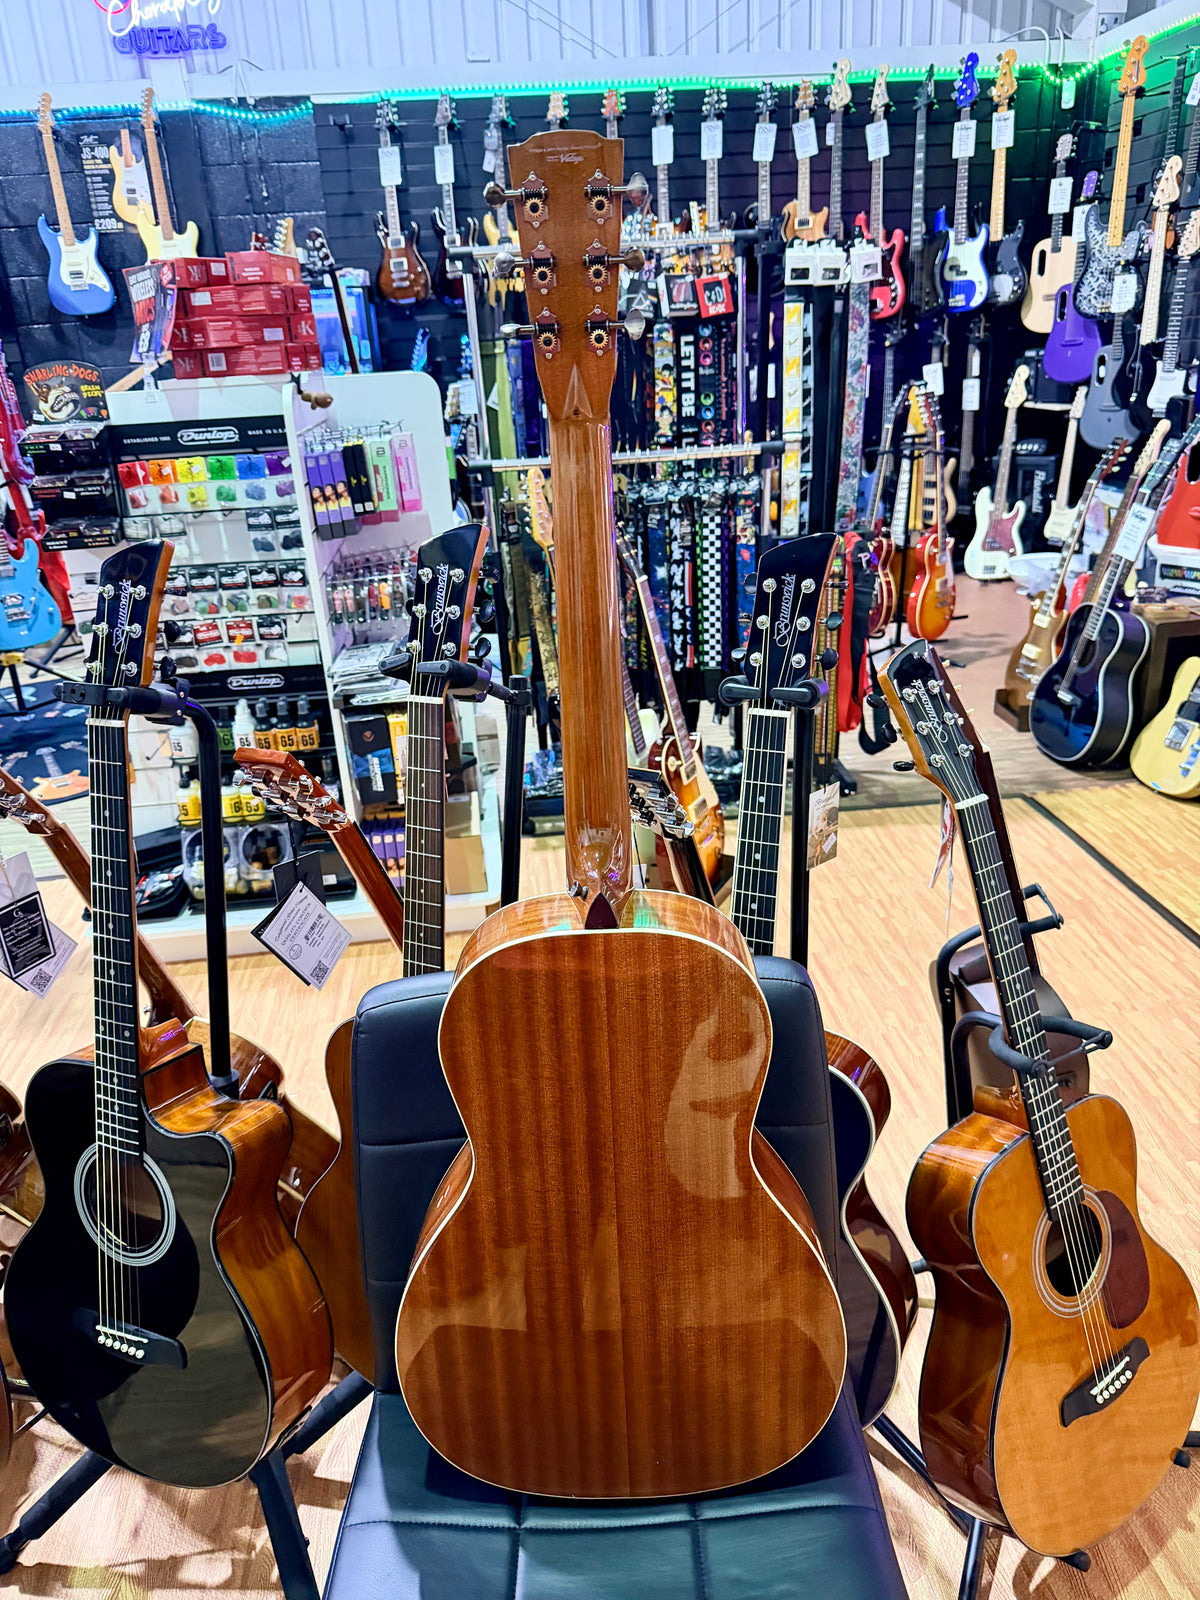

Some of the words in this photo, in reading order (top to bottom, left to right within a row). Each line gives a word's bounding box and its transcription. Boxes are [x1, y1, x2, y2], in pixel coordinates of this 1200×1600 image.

[113, 23, 227, 54] GUITARS
[81, 147, 109, 159] JS-400
[560, 152, 584, 164] Vintage
[708, 302, 727, 315] AC/DC
[680, 335, 695, 369] LET
[23, 364, 70, 386] SNARLING
[71, 363, 99, 382] DOGS
[681, 371, 696, 392] IT
[681, 393, 697, 418] BE
[181, 428, 236, 442] Dunlop
[1032, 469, 1047, 513] Randall
[430, 563, 449, 635] Brunswick
[112, 579, 131, 654] Brunswick
[773, 573, 796, 647] Brunswick
[231, 675, 282, 688] Dunlop
[911, 679, 948, 743] Brunswick
[239, 737, 252, 747] 65
[257, 737, 271, 749] 65
[280, 734, 295, 747] 65
[301, 734, 315, 747] 65
